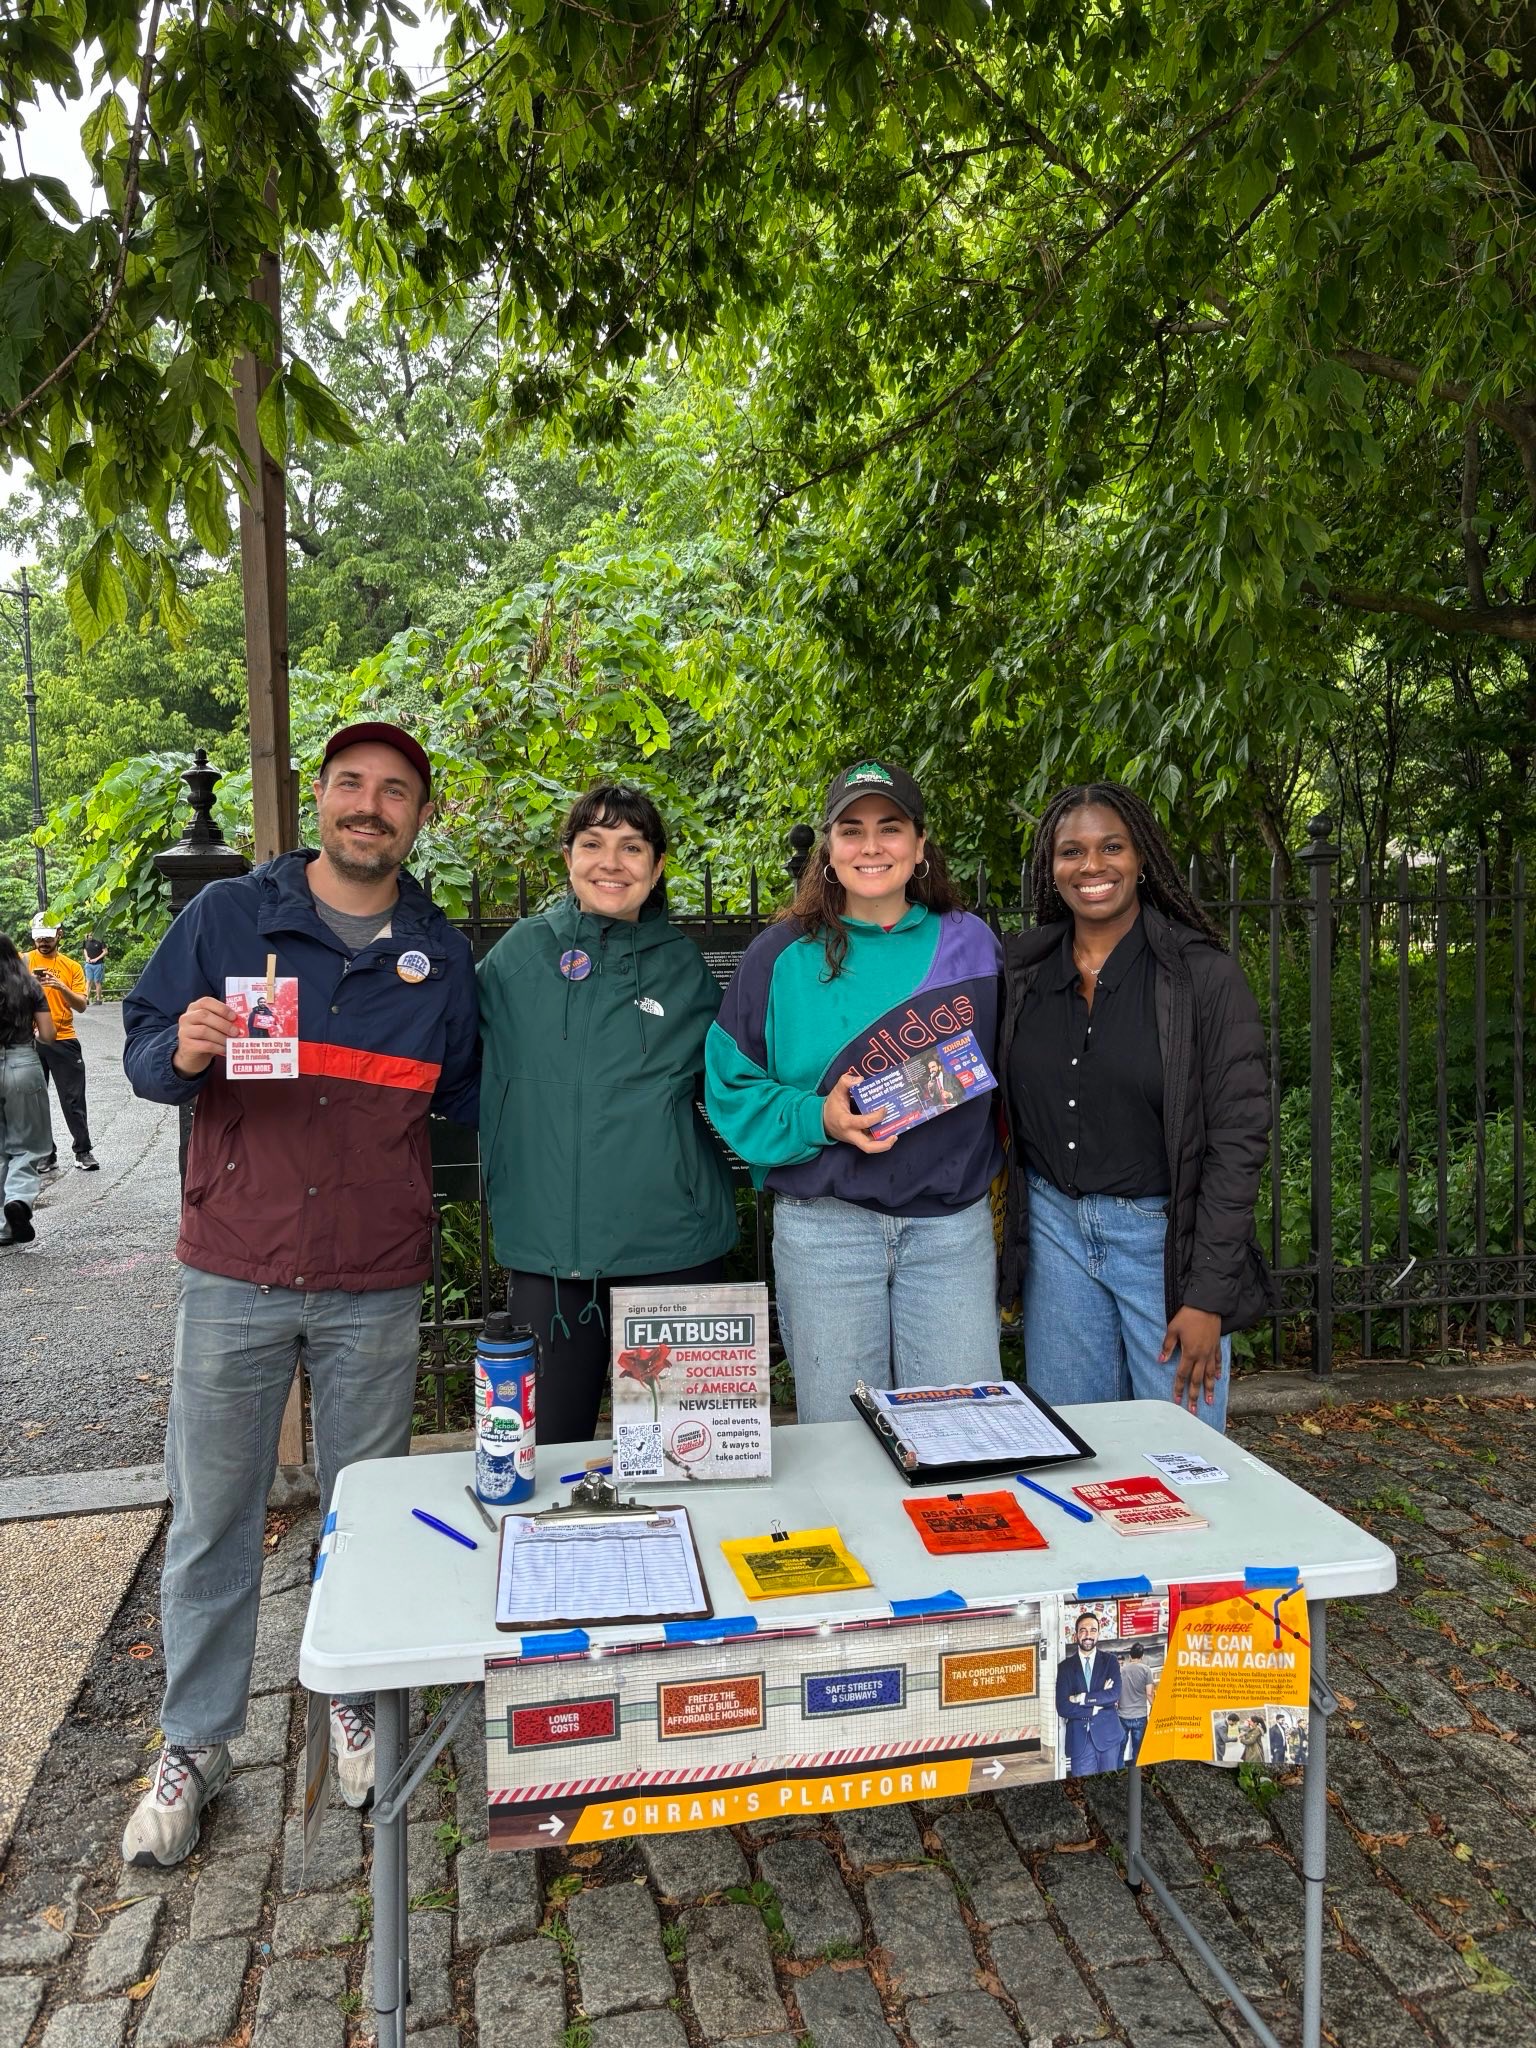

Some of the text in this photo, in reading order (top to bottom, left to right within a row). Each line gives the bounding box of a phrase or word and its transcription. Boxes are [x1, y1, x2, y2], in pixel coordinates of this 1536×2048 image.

[403, 954, 428, 972] FREEZE
[848, 996, 974, 1077] didas
[942, 1036, 971, 1054] ZOHRAN
[628, 1304, 687, 1314] sign up for the
[634, 1321, 744, 1344] FLATBUSH
[676, 1350, 756, 1362] DEMOCRATIC
[686, 1366, 757, 1378] SOCIALISTS
[686, 1382, 757, 1394] of AMERICA
[895, 1388, 976, 1401] ZOHRAN
[680, 1399, 757, 1411] NEWSLETTER
[712, 1417, 761, 1425] local events,
[717, 1429, 761, 1438] campaigns,
[730, 1442, 749, 1450] ways
[735, 1452, 762, 1460] action!
[1077, 1484, 1109, 1494] BUILD
[1083, 1488, 1128, 1499] THE LEFT
[1115, 1491, 1167, 1502] FIGHT THE
[1140, 1497, 1172, 1505] RIGHT
[921, 1508, 974, 1518] DSA-101
[1114, 1508, 1183, 1519] DEMOCRATIC
[1119, 1511, 1191, 1524] SOCIALISTS
[1182, 1623, 1253, 1632] A CITY WHERE
[1186, 1633, 1253, 1651] WE CAN
[1177, 1651, 1295, 1669] DREAM AGAIN
[952, 1663, 1026, 1680] TAX CORPORATIONS
[972, 1675, 1007, 1687] & THE 1%
[825, 1680, 883, 1695] SAFE STREETS
[688, 1691, 736, 1704] FREEZE THE
[832, 1690, 877, 1703] & SUBWAYS
[685, 1704, 707, 1714] RENT
[716, 1700, 739, 1710] BUILD
[549, 1713, 579, 1724] LOWER
[667, 1707, 758, 1726] AFFORDABLE HOUSING
[551, 1723, 580, 1734] COSTS
[602, 1770, 937, 1830] ZOHRAN'S PLATFORM
